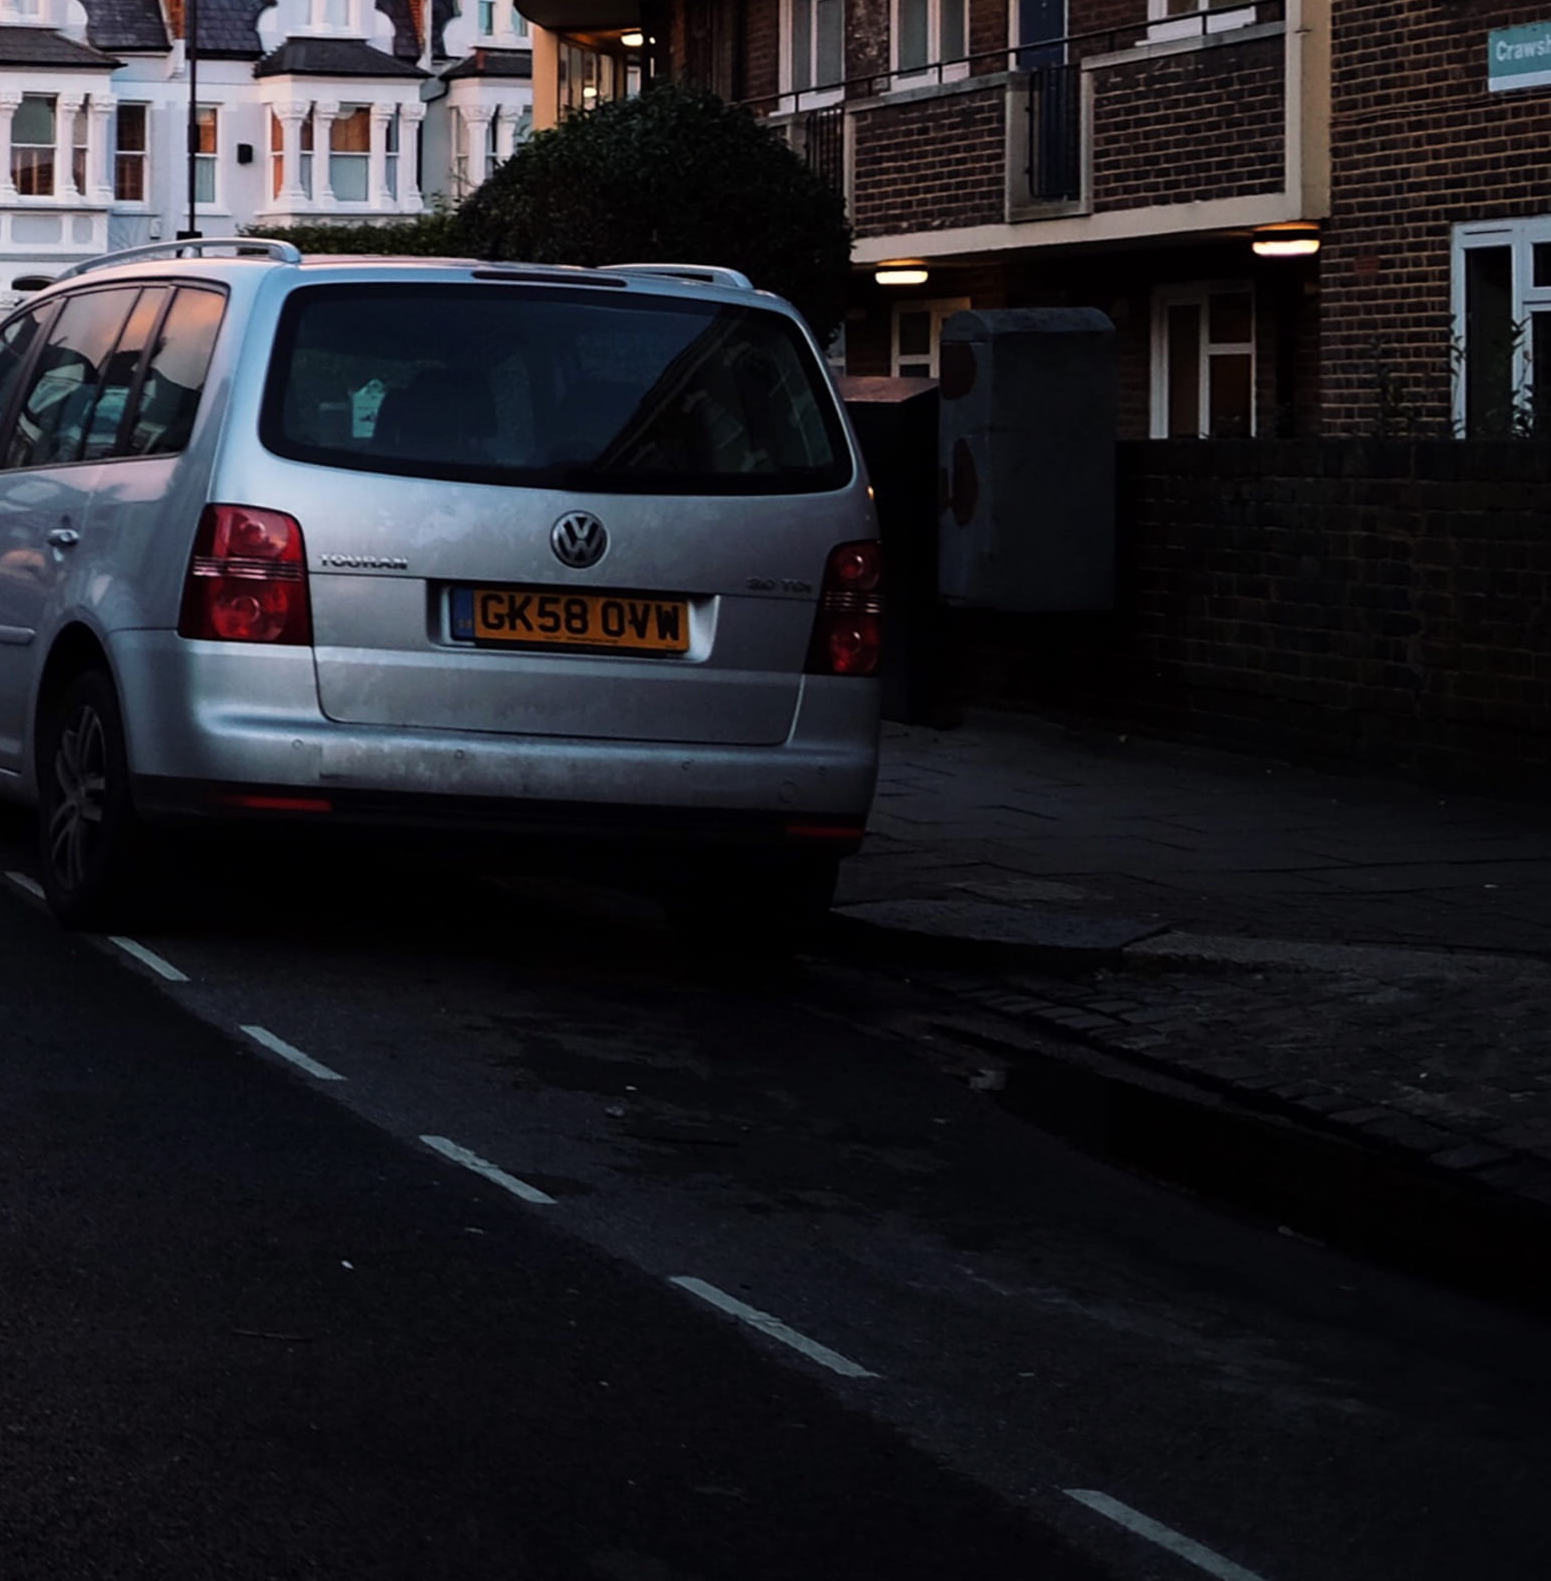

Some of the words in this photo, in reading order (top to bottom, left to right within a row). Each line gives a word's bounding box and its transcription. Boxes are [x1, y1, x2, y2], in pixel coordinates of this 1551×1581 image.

[320, 554, 408, 570] TOURAN
[480, 593, 590, 635] GK58
[600, 600, 680, 641] OVW
